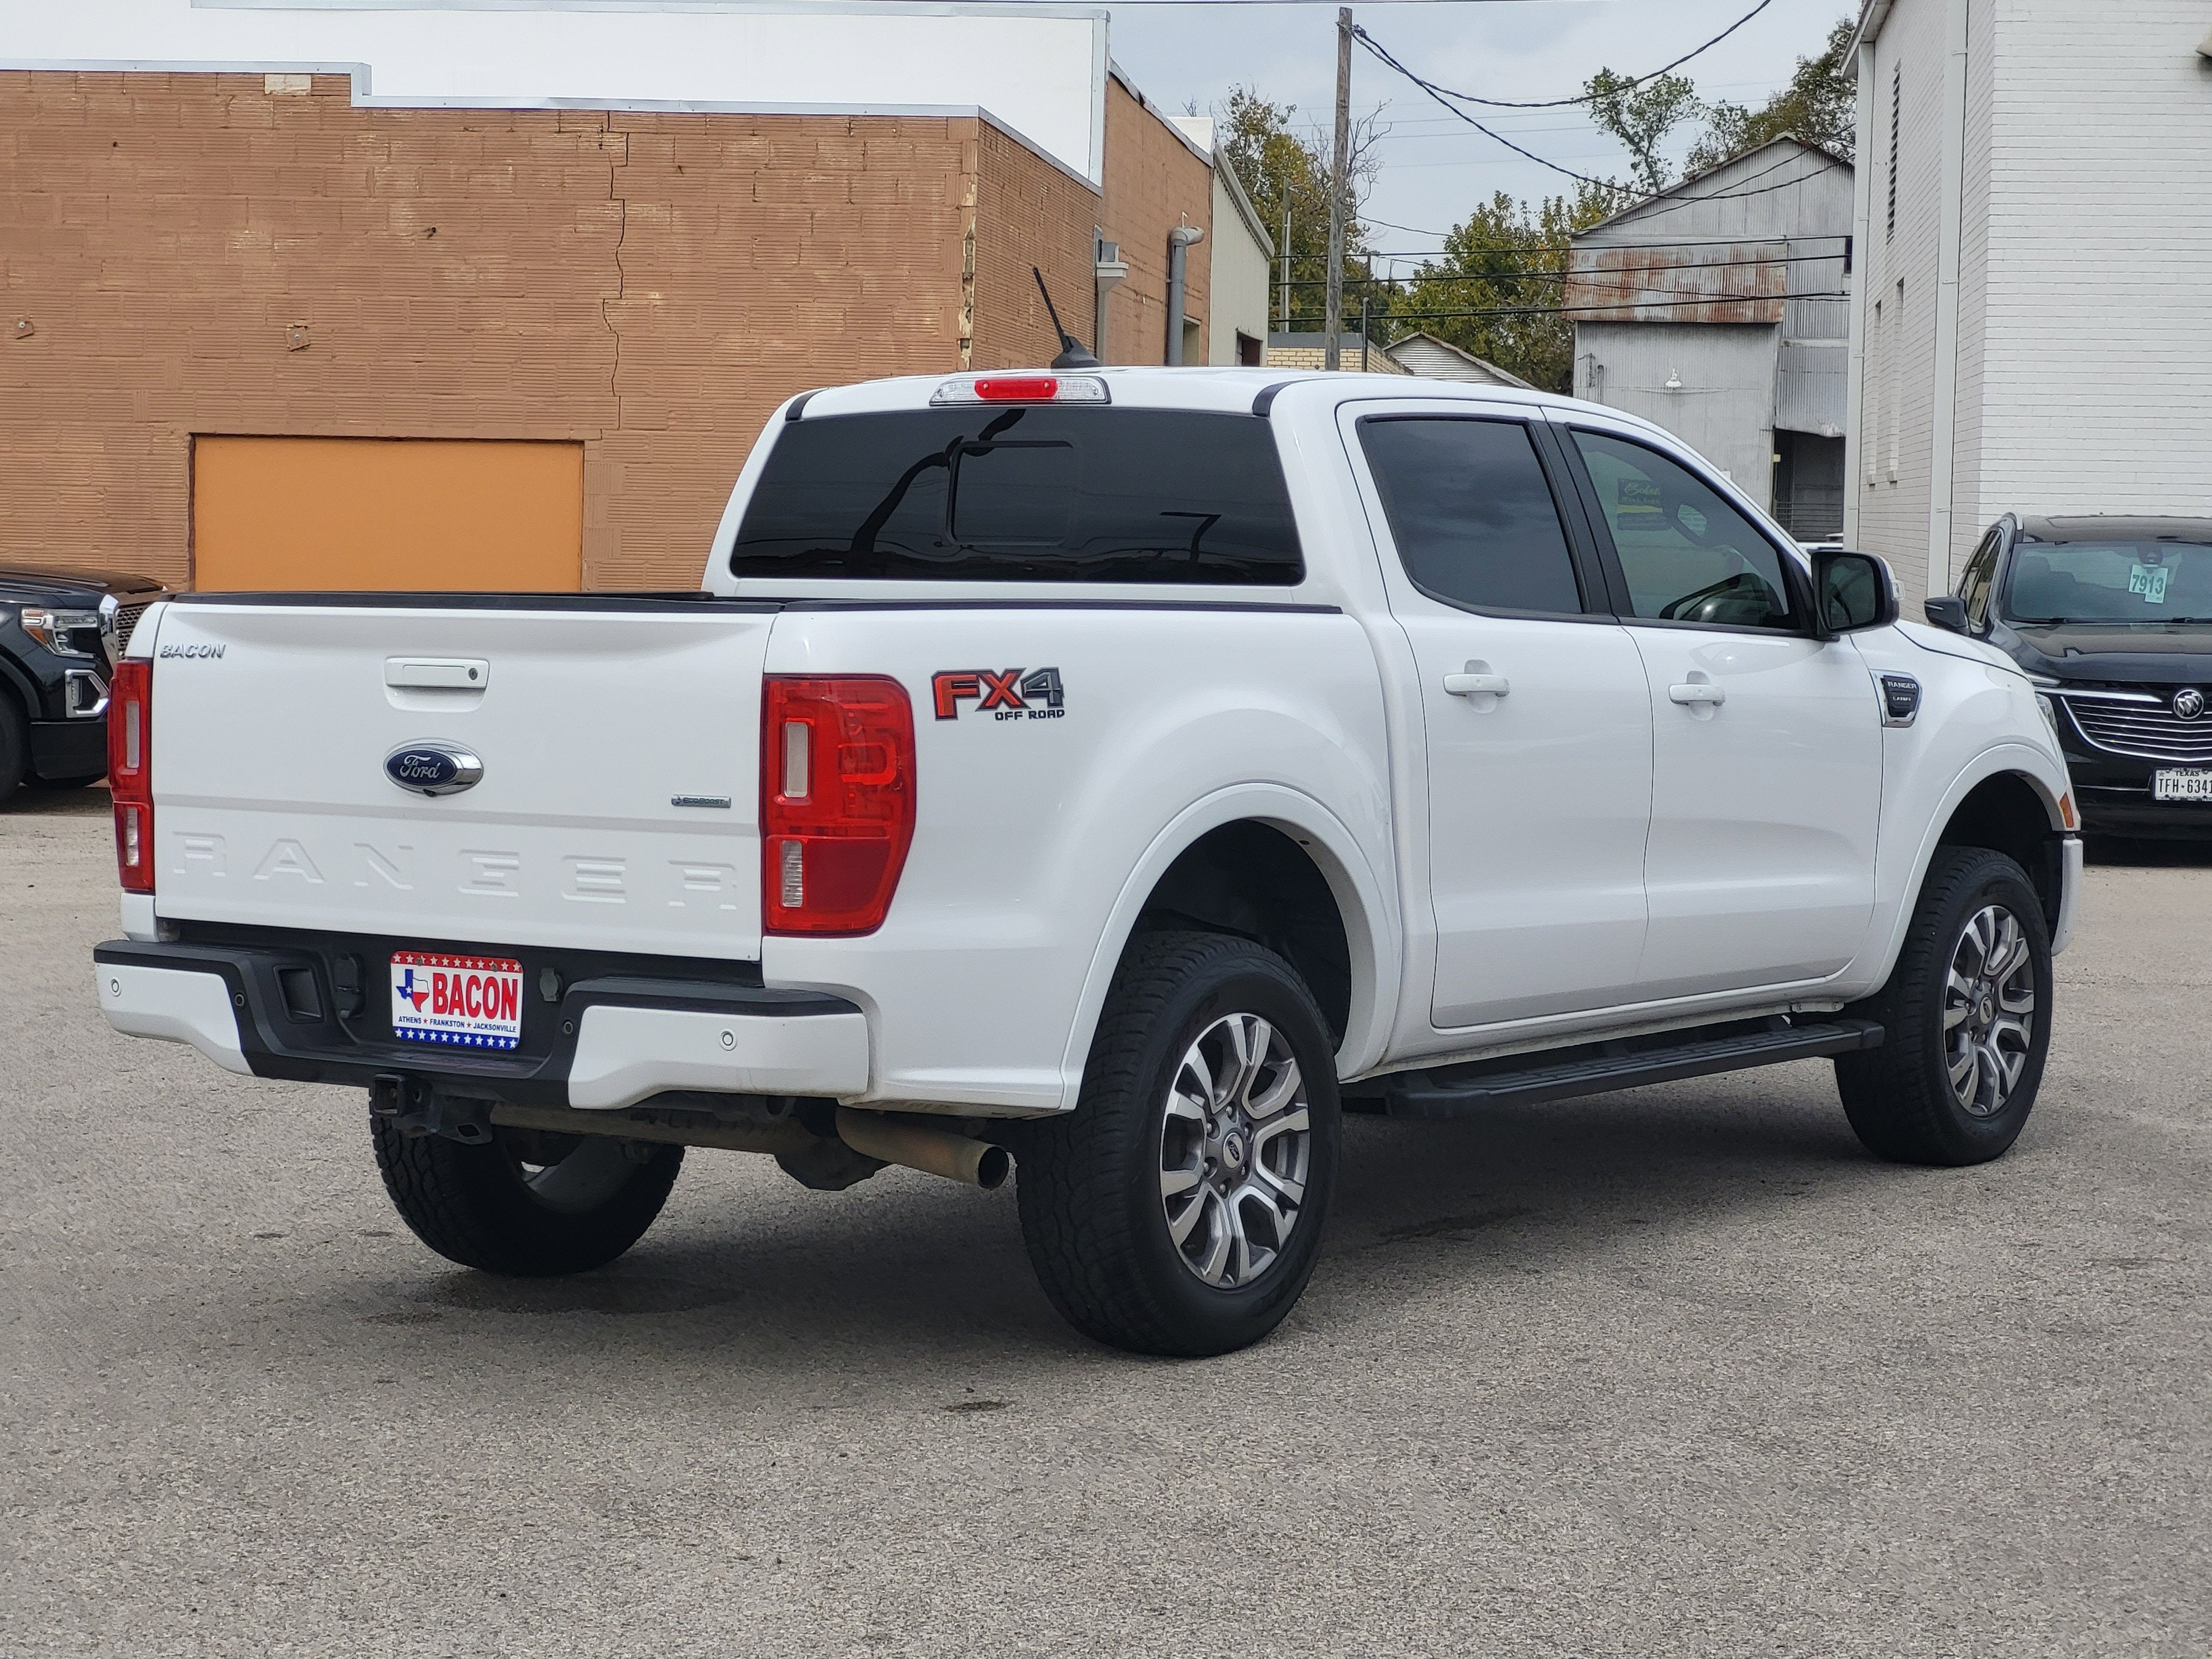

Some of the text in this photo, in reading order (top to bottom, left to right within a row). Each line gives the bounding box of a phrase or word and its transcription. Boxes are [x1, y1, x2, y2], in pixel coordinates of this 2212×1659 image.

[2132, 574, 2164, 594] 7913
[160, 643, 226, 659] BACON
[931, 666, 1065, 721] FX4
[995, 709, 1065, 721] OFF ROAD
[399, 755, 441, 779] Ford
[172, 831, 737, 910] RANGER
[432, 972, 518, 1021] BACON
[429, 1018, 465, 1028] FRANKSTON
[473, 1022, 517, 1033] JACKSONVILLE
